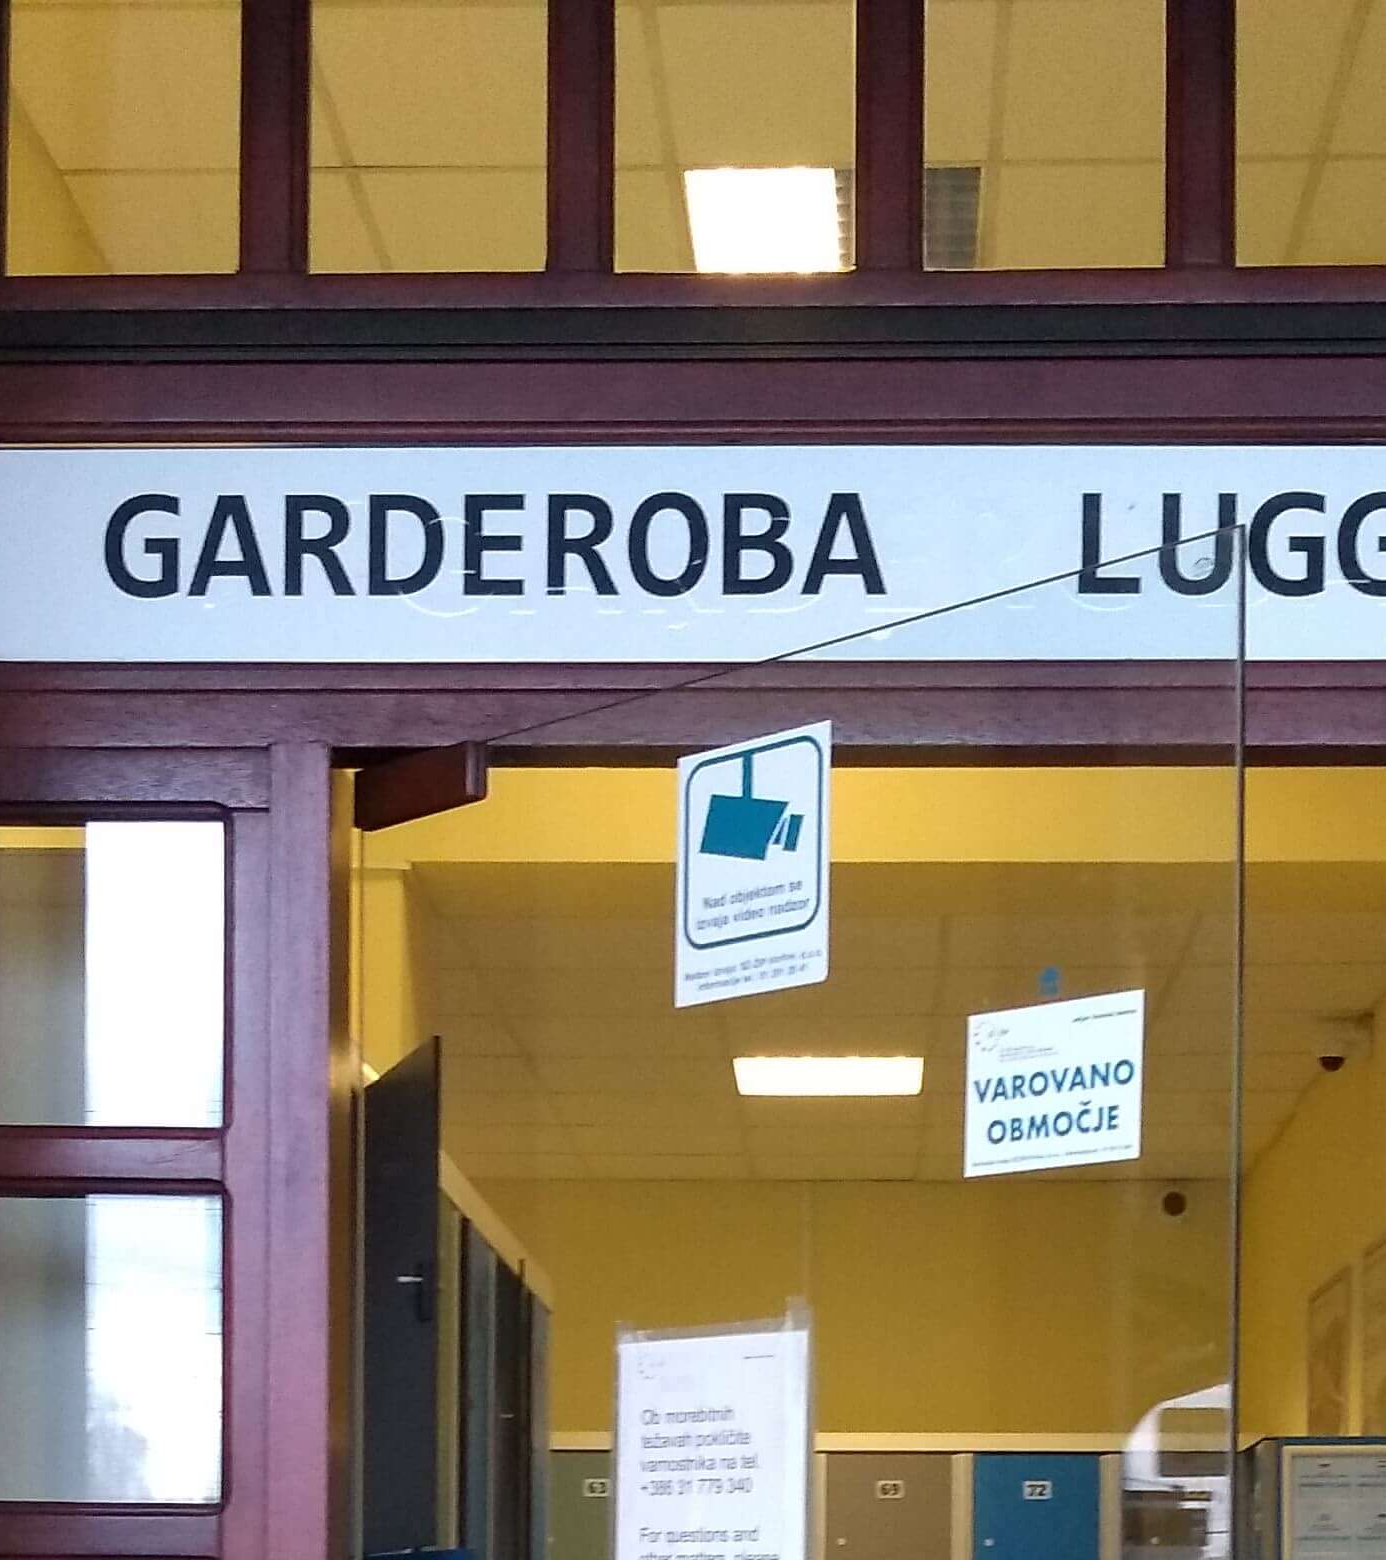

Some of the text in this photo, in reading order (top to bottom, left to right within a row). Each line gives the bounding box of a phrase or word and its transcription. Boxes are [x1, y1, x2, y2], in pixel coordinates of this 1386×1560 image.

[103, 491, 885, 599] GARDEROBA
[973, 1059, 1135, 1104] VAROVANO
[987, 1100, 1120, 1145] OBMOČJE
[1026, 1484, 1046, 1497] 72
[639, 1526, 760, 1544] For questions and
